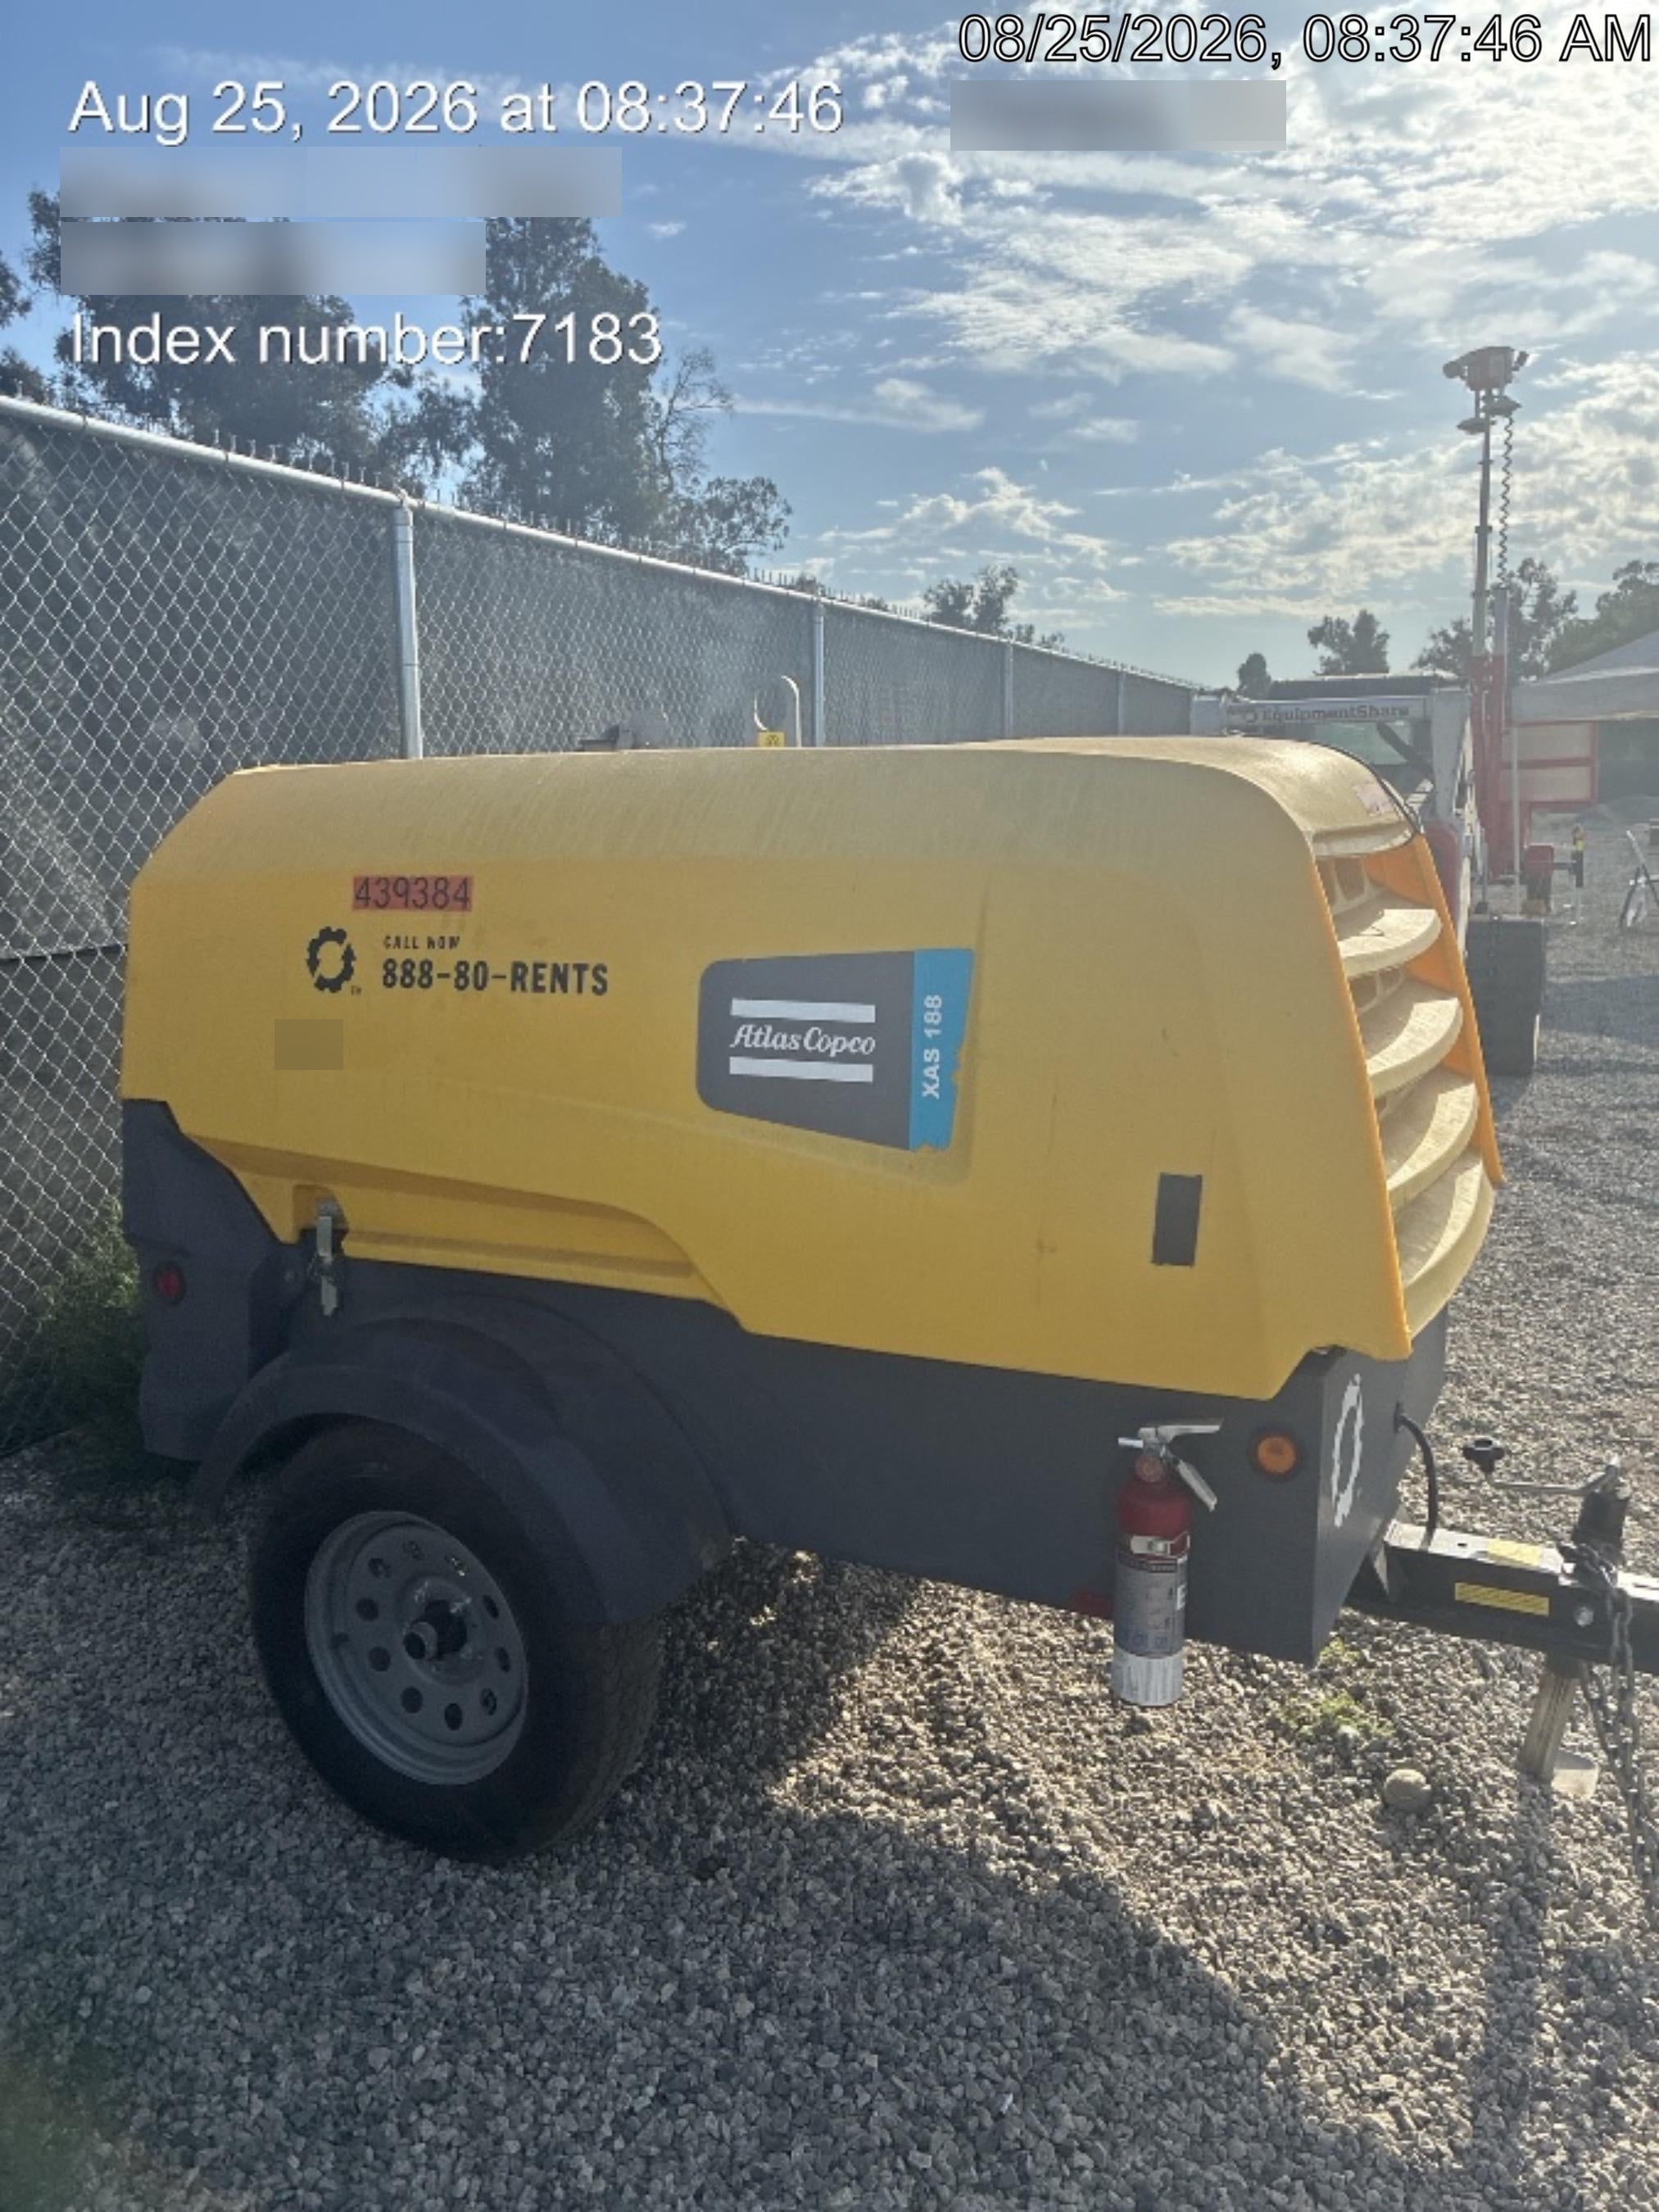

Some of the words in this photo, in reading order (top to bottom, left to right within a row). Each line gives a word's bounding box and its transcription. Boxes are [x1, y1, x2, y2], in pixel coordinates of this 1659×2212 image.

[354, 877, 471, 910] 439384
[383, 936, 419, 950] CALL
[383, 958, 609, 996] 888-80-RENTS
[923, 995, 943, 1039] 188
[922, 1048, 941, 1099] XAS
